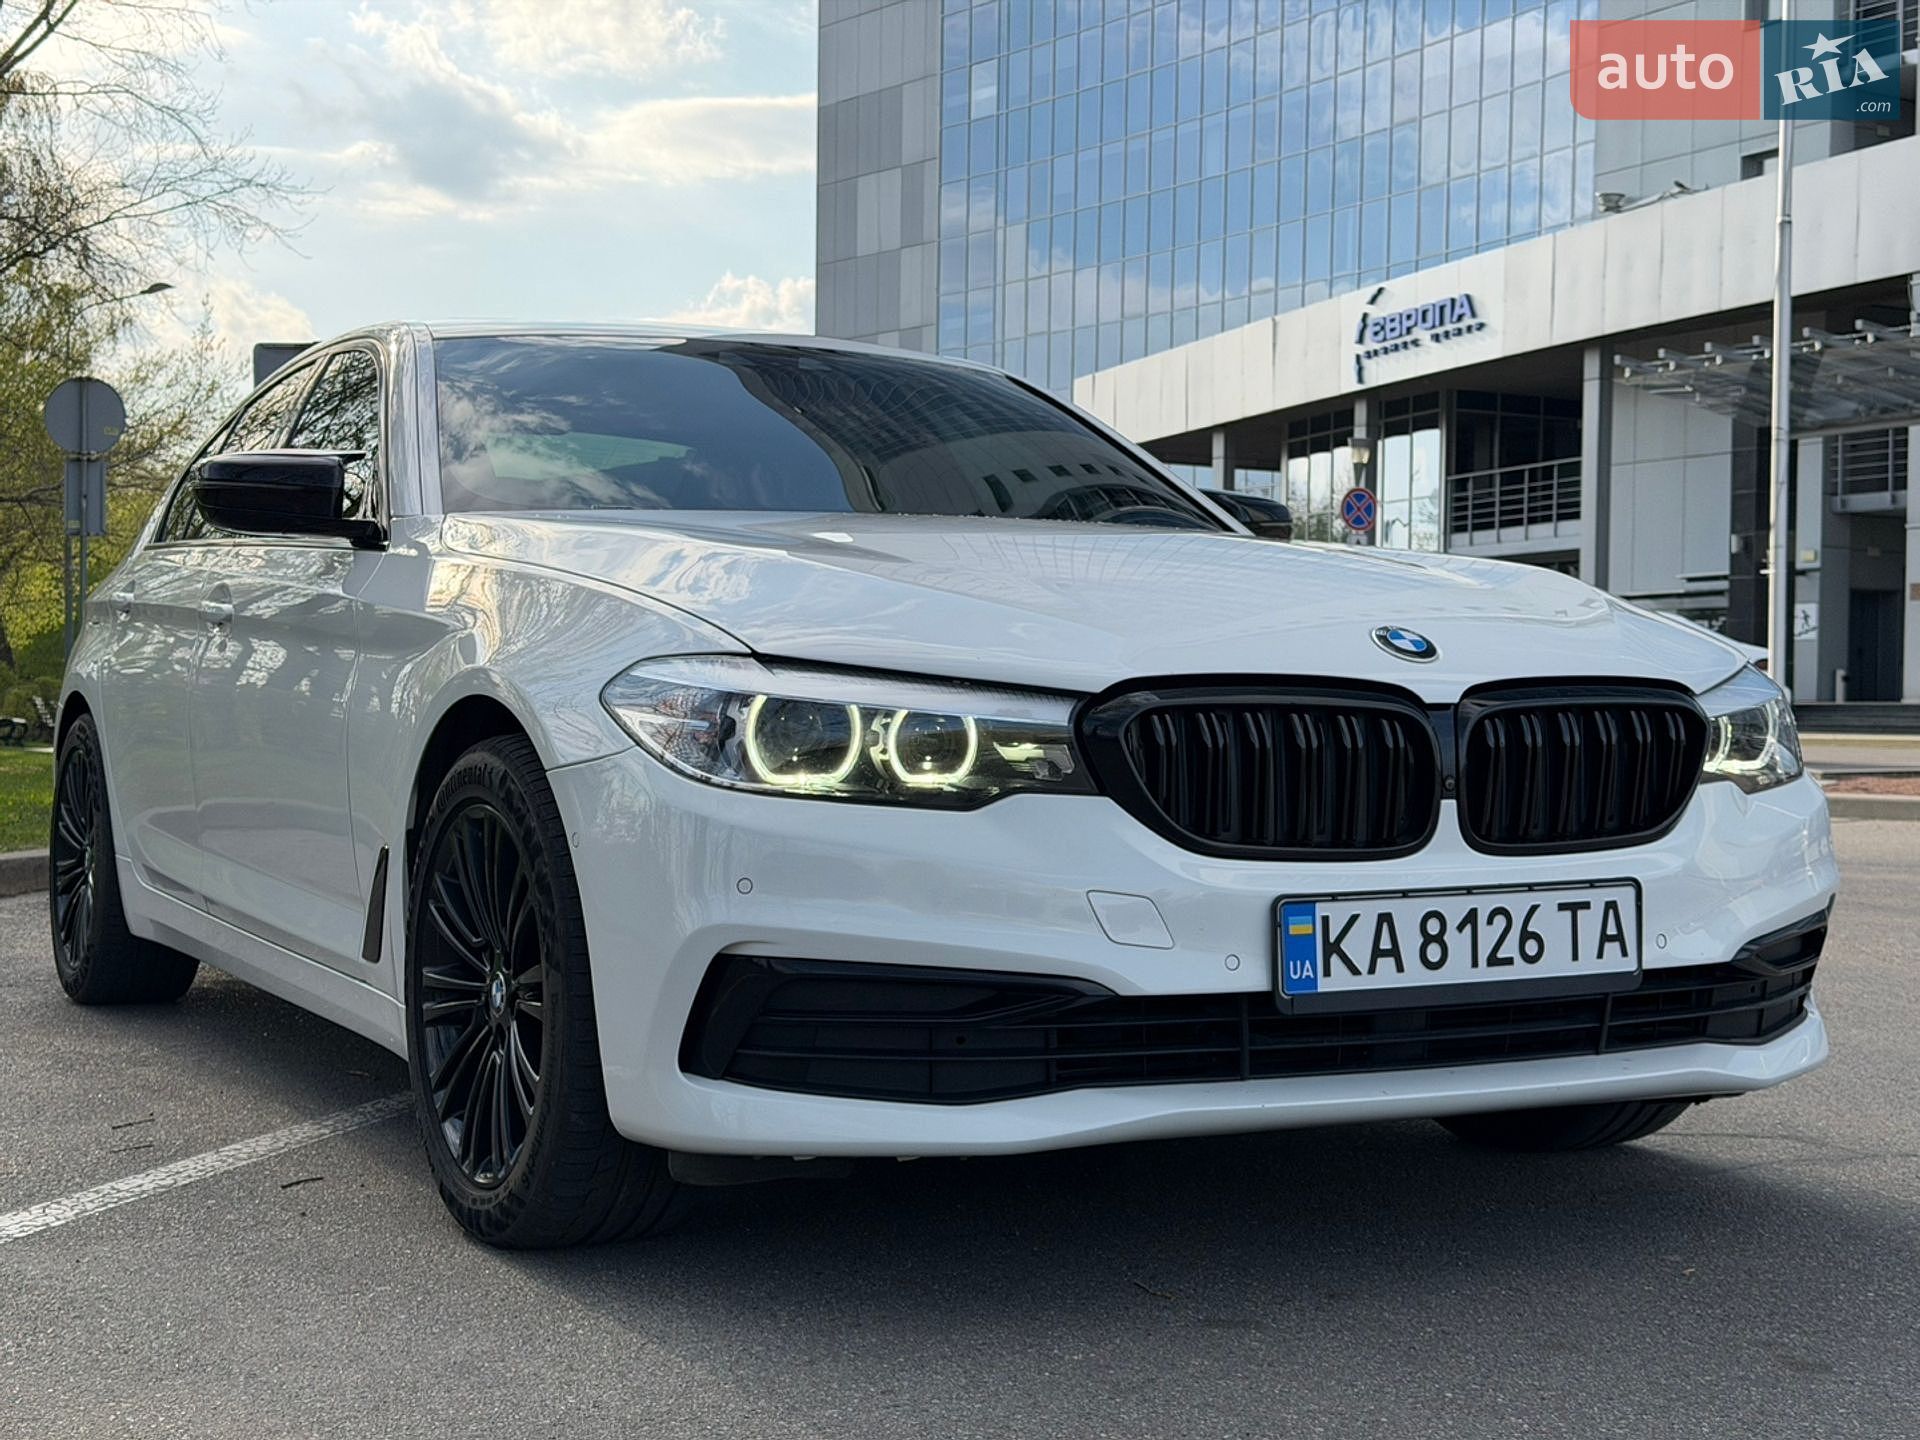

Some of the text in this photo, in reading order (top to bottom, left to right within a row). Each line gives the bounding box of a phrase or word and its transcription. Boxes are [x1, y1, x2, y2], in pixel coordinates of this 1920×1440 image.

[1369, 293, 1477, 343] ЄВРОПА
[1321, 900, 1629, 977] KA 8126 TA
[1290, 959, 1314, 980] UA
